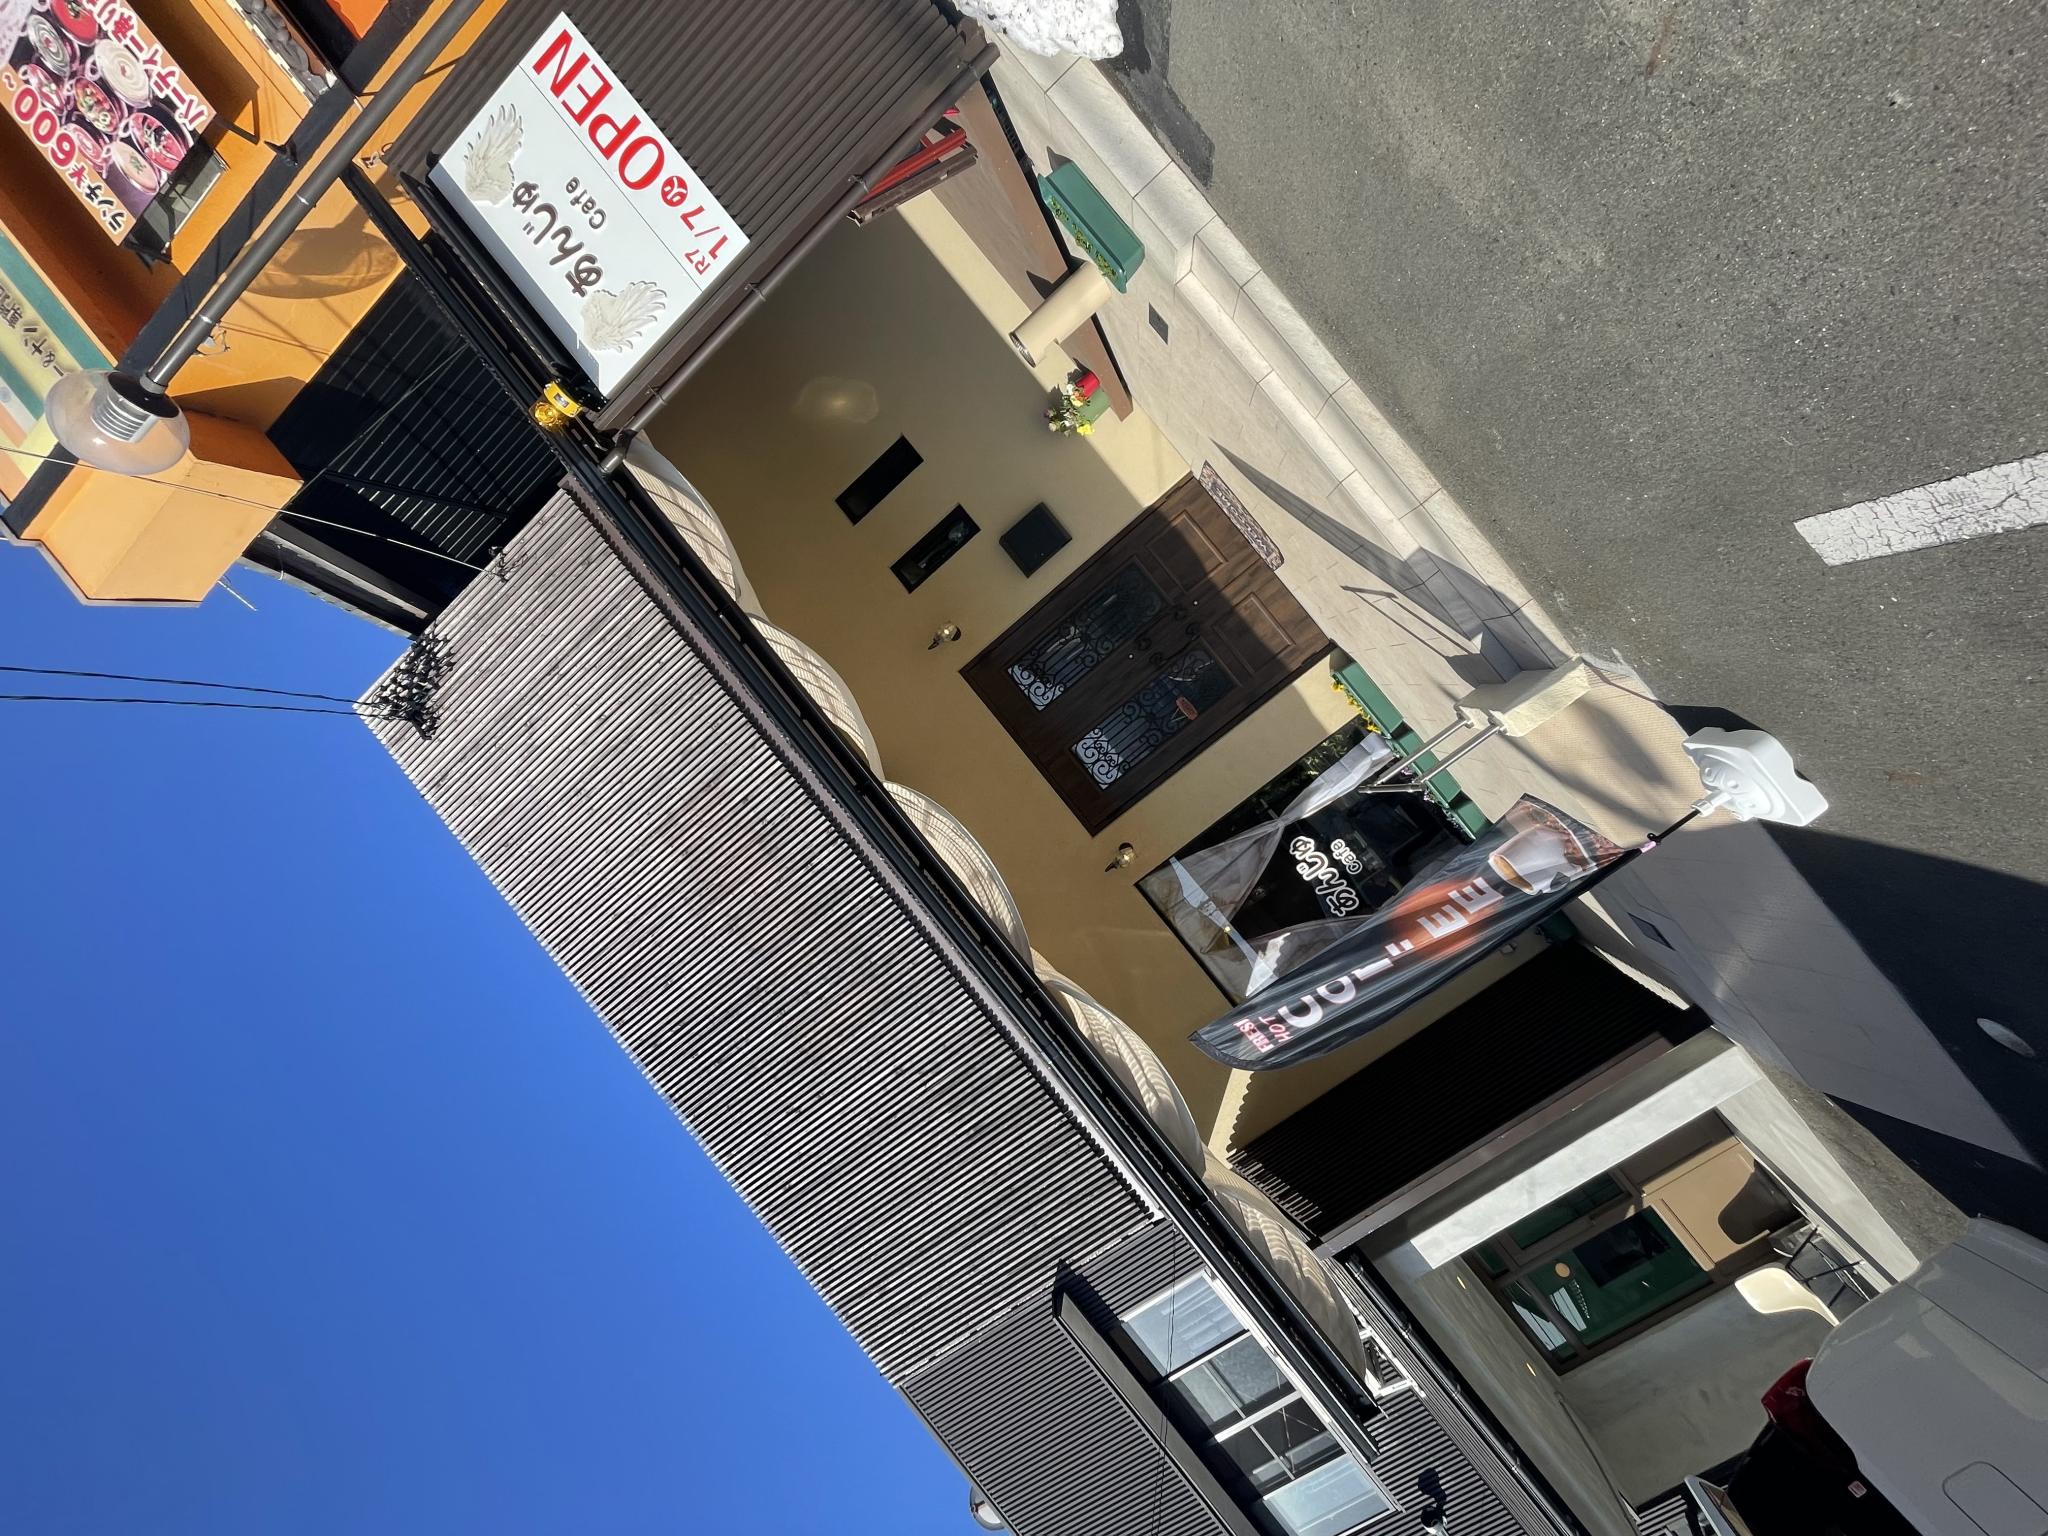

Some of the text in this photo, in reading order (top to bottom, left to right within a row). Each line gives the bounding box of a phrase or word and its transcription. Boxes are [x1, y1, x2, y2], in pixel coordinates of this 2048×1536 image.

[532, 29, 665, 190] OPEN
[513, 181, 603, 298] あんじゅ
[685, 249, 711, 275] R7
[1289, 836, 1360, 917] あんじゅ
[1257, 1015, 1294, 1044] HOT
